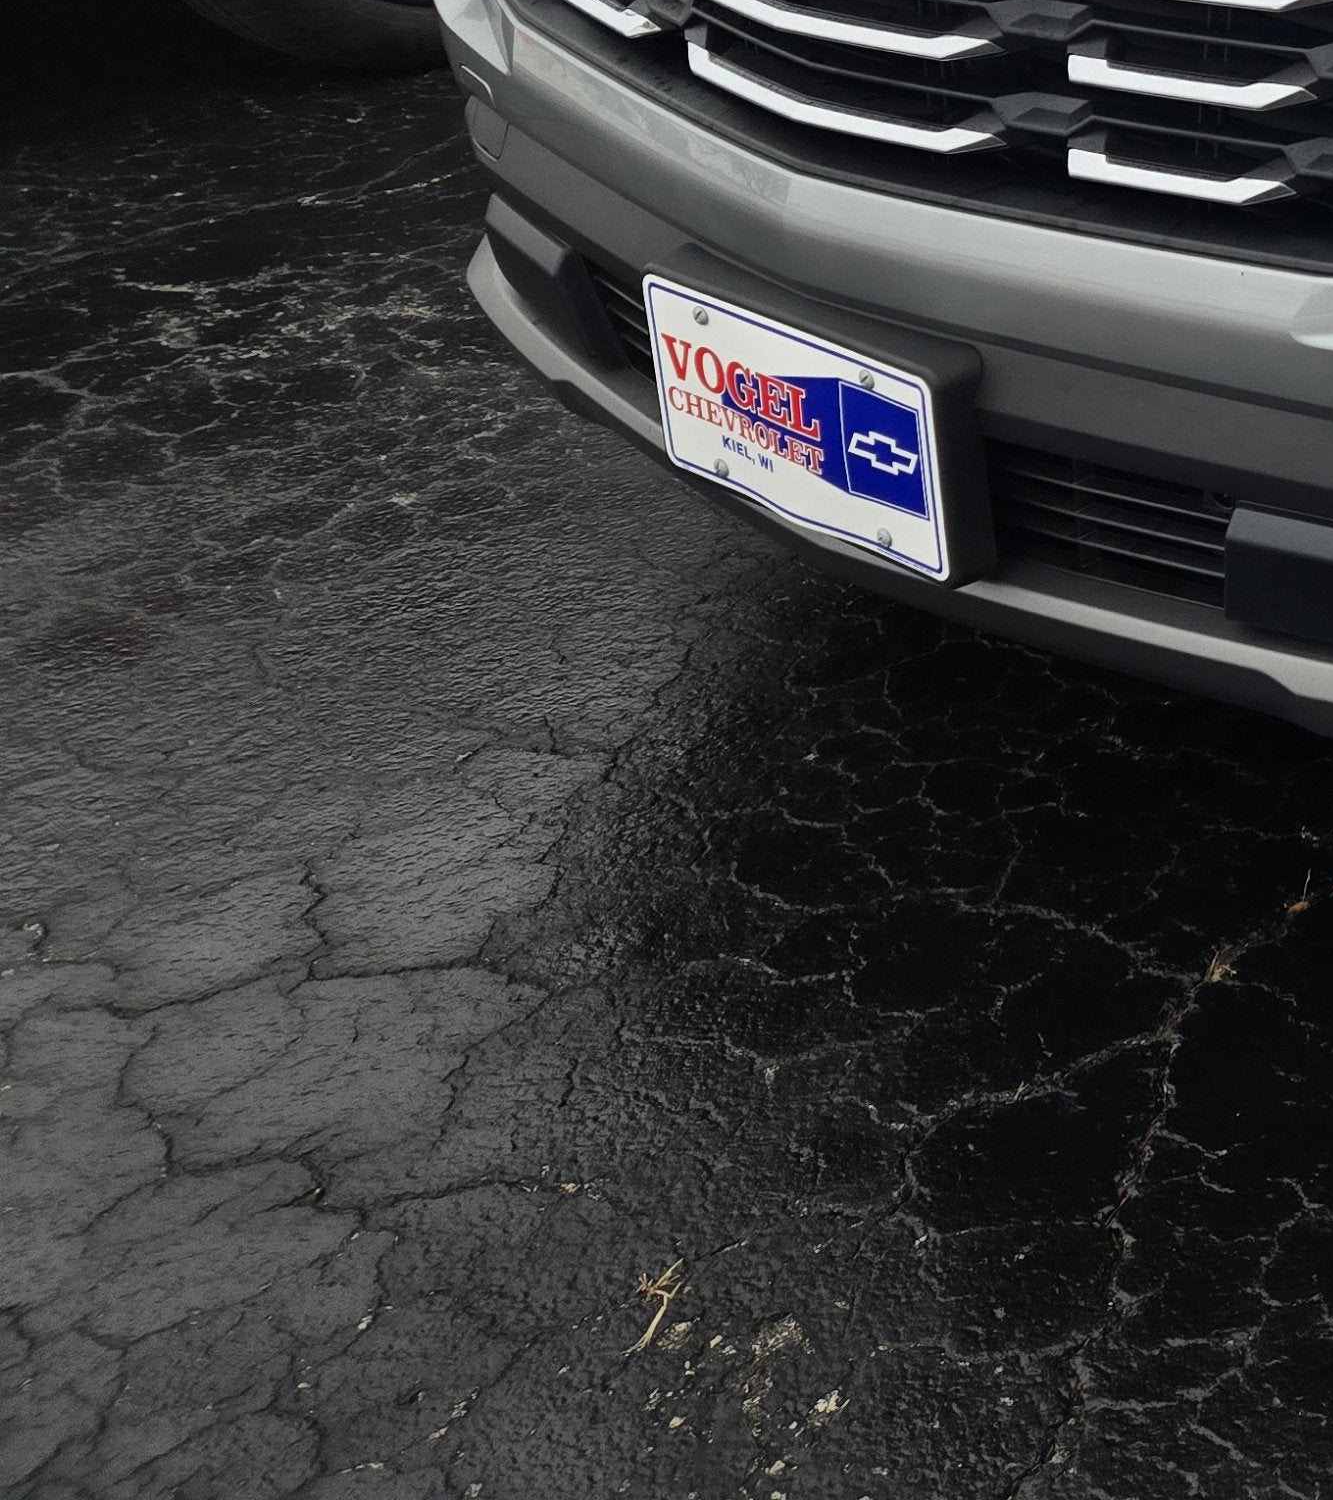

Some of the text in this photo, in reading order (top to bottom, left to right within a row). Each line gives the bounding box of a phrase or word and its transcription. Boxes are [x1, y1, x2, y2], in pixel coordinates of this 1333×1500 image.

[661, 333, 822, 441] VOGEL
[668, 386, 825, 476] CHEVROLET
[721, 435, 774, 473] KIEL, WI
